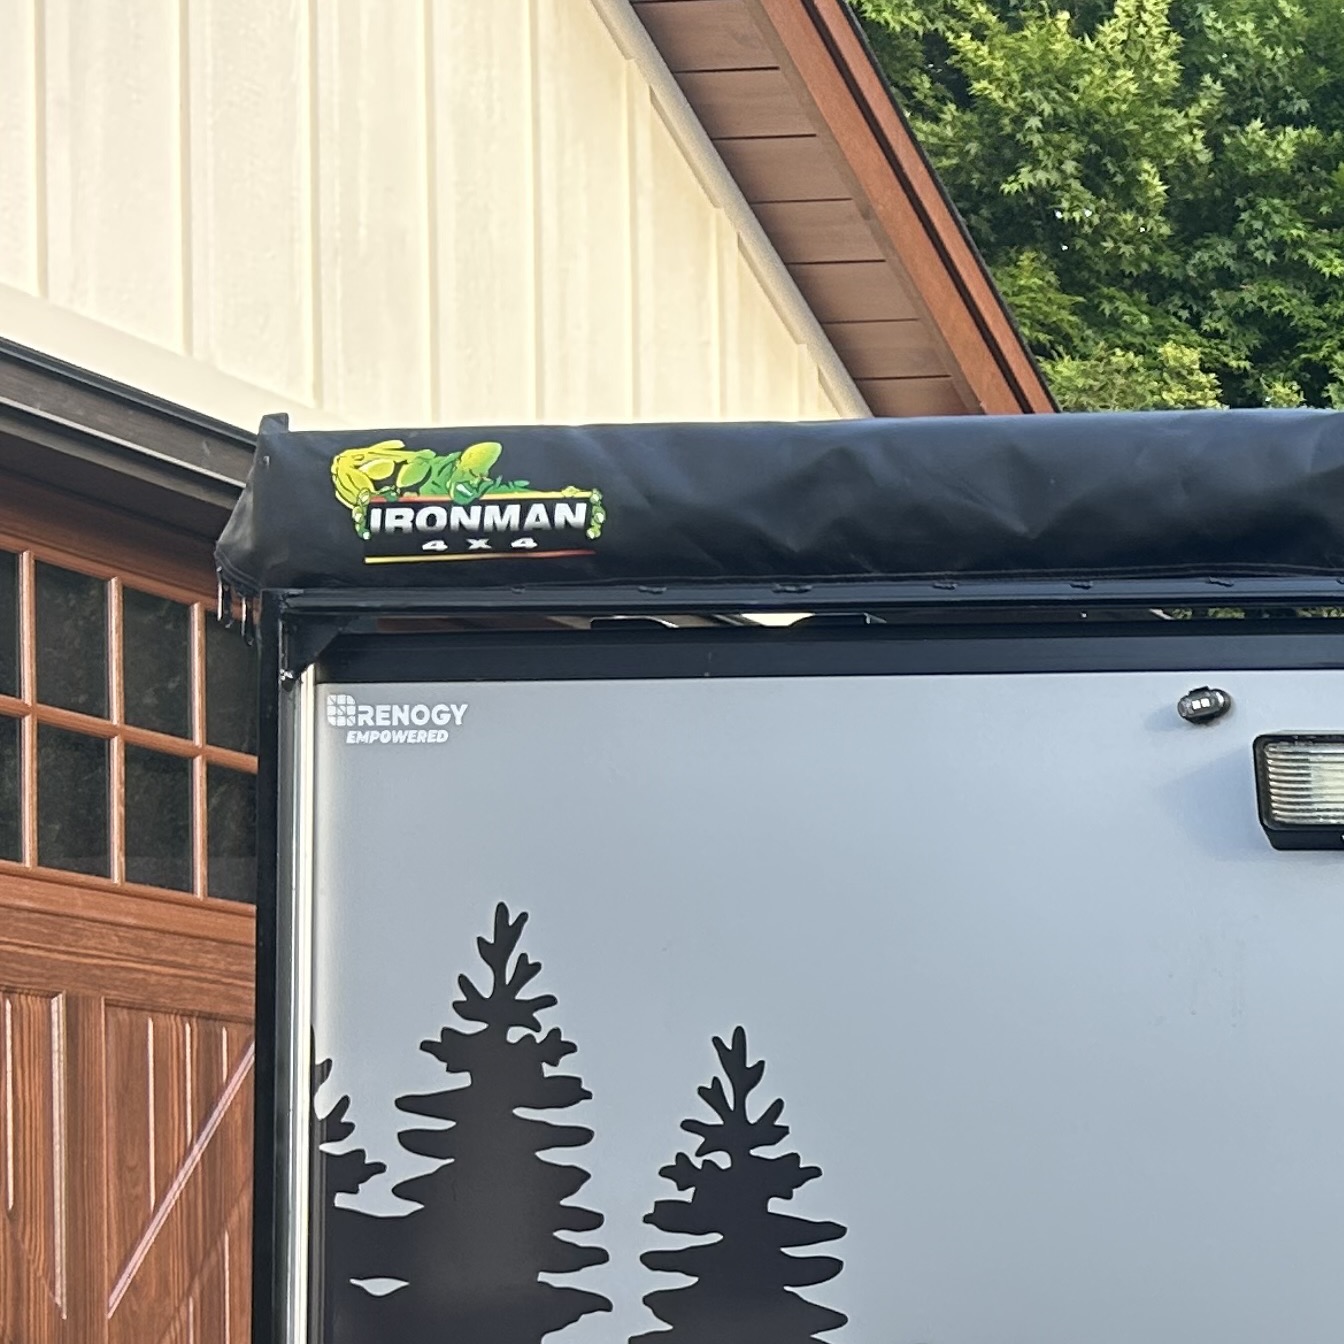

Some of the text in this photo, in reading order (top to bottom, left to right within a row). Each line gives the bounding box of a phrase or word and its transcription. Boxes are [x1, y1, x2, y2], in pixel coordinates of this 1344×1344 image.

[369, 502, 587, 534] IRONMAN
[358, 704, 469, 726] RENOGY
[346, 729, 449, 744] EMPOWERED
